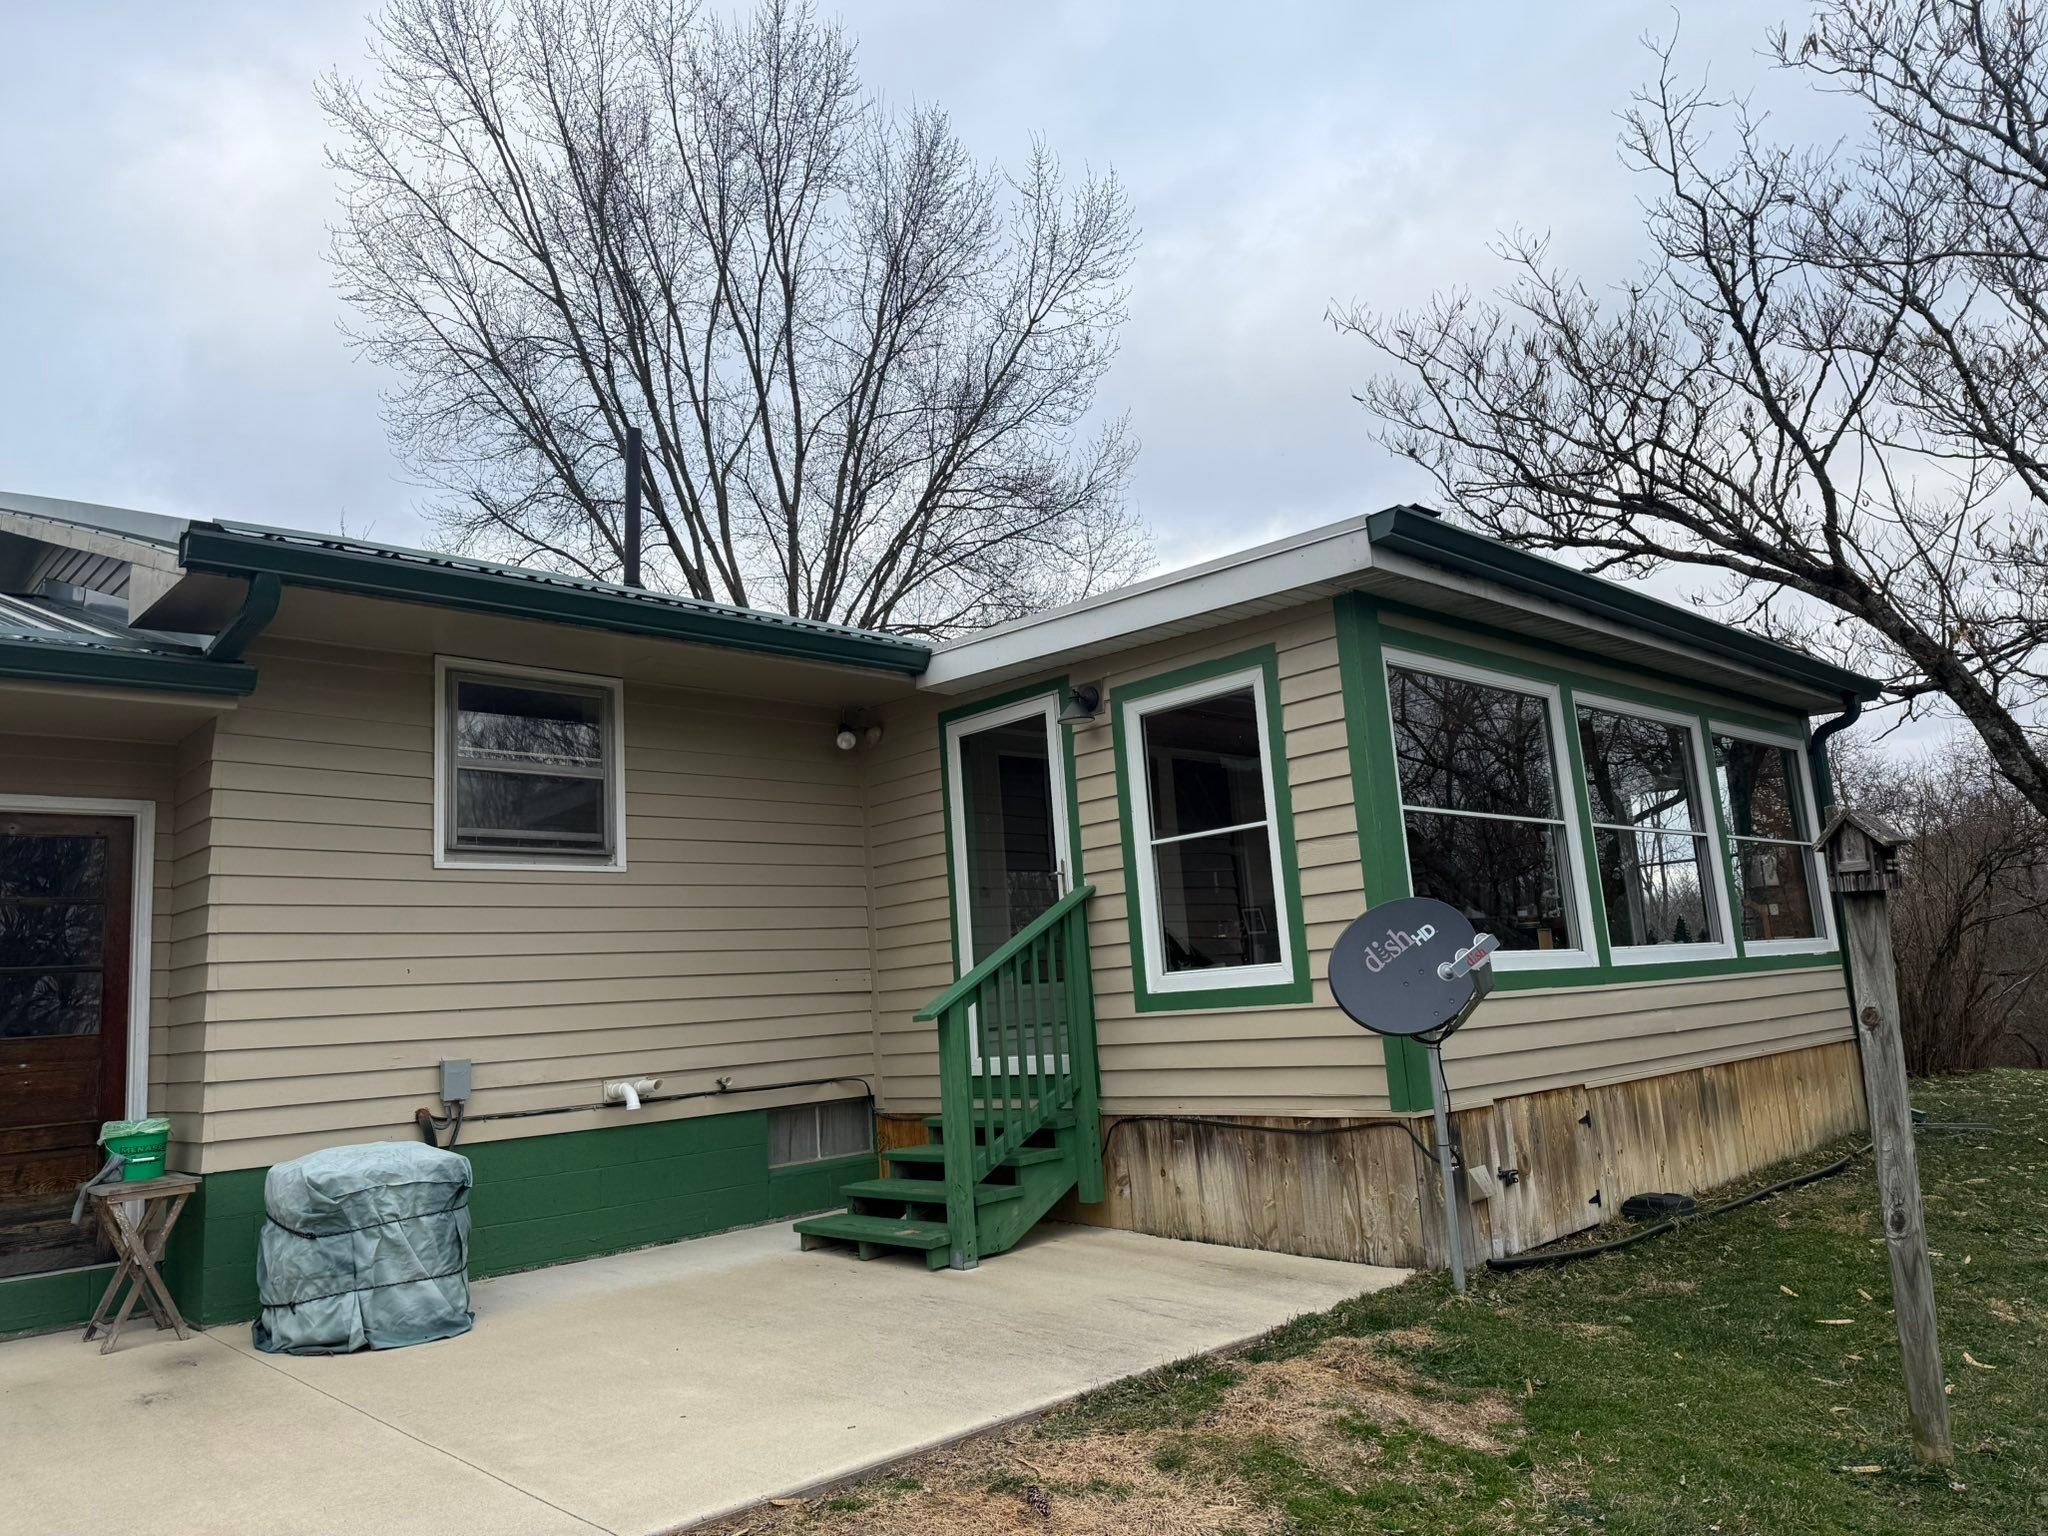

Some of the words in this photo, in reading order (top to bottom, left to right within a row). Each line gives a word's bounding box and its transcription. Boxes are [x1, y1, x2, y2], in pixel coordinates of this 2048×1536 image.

[1364, 929, 1414, 973] dish
[1411, 923, 1436, 947] HD
[1466, 947, 1487, 967] dish
